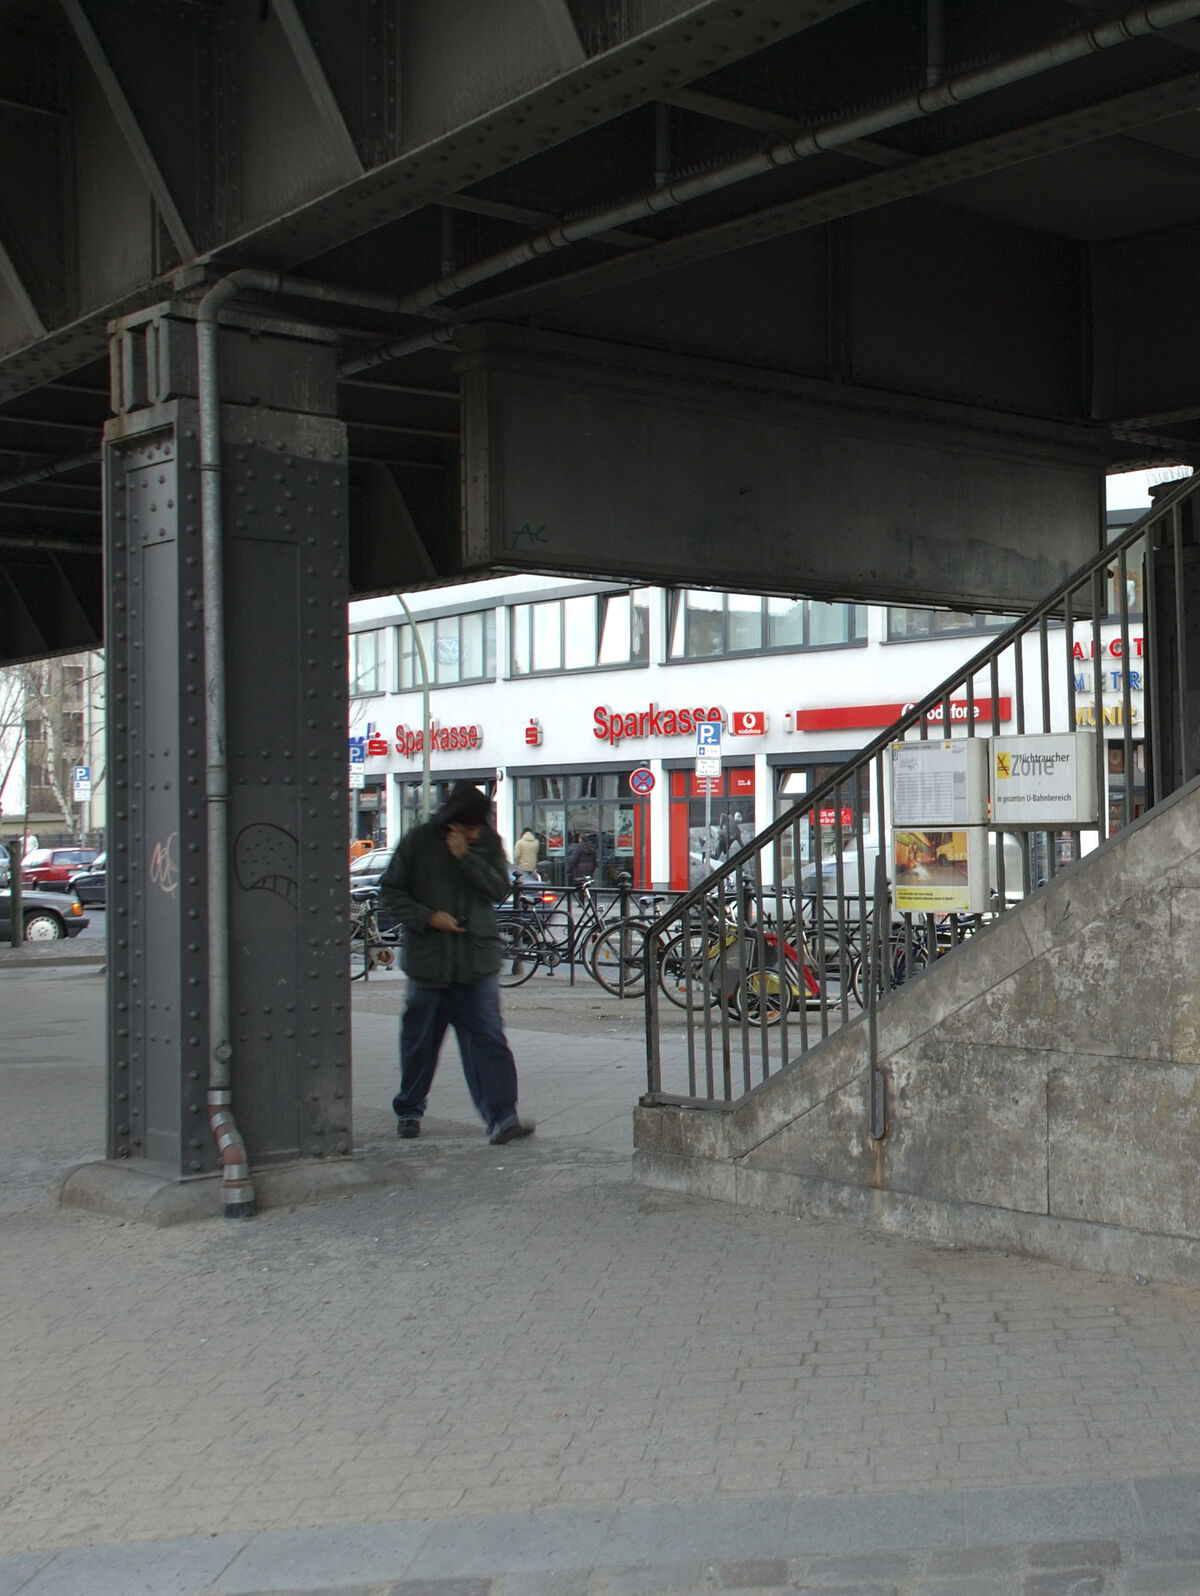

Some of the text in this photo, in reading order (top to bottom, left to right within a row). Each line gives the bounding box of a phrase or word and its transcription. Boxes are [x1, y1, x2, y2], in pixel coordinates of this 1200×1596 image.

[593, 702, 723, 746] Sparkasse
[700, 724, 715, 744] P
[395, 721, 478, 760] Spakasse
[1011, 754, 1055, 777] Zone
[1020, 752, 1070, 763] Nichtraucher
[76, 768, 87, 781] P
[1026, 792, 1072, 802] U-Bahnbereich
